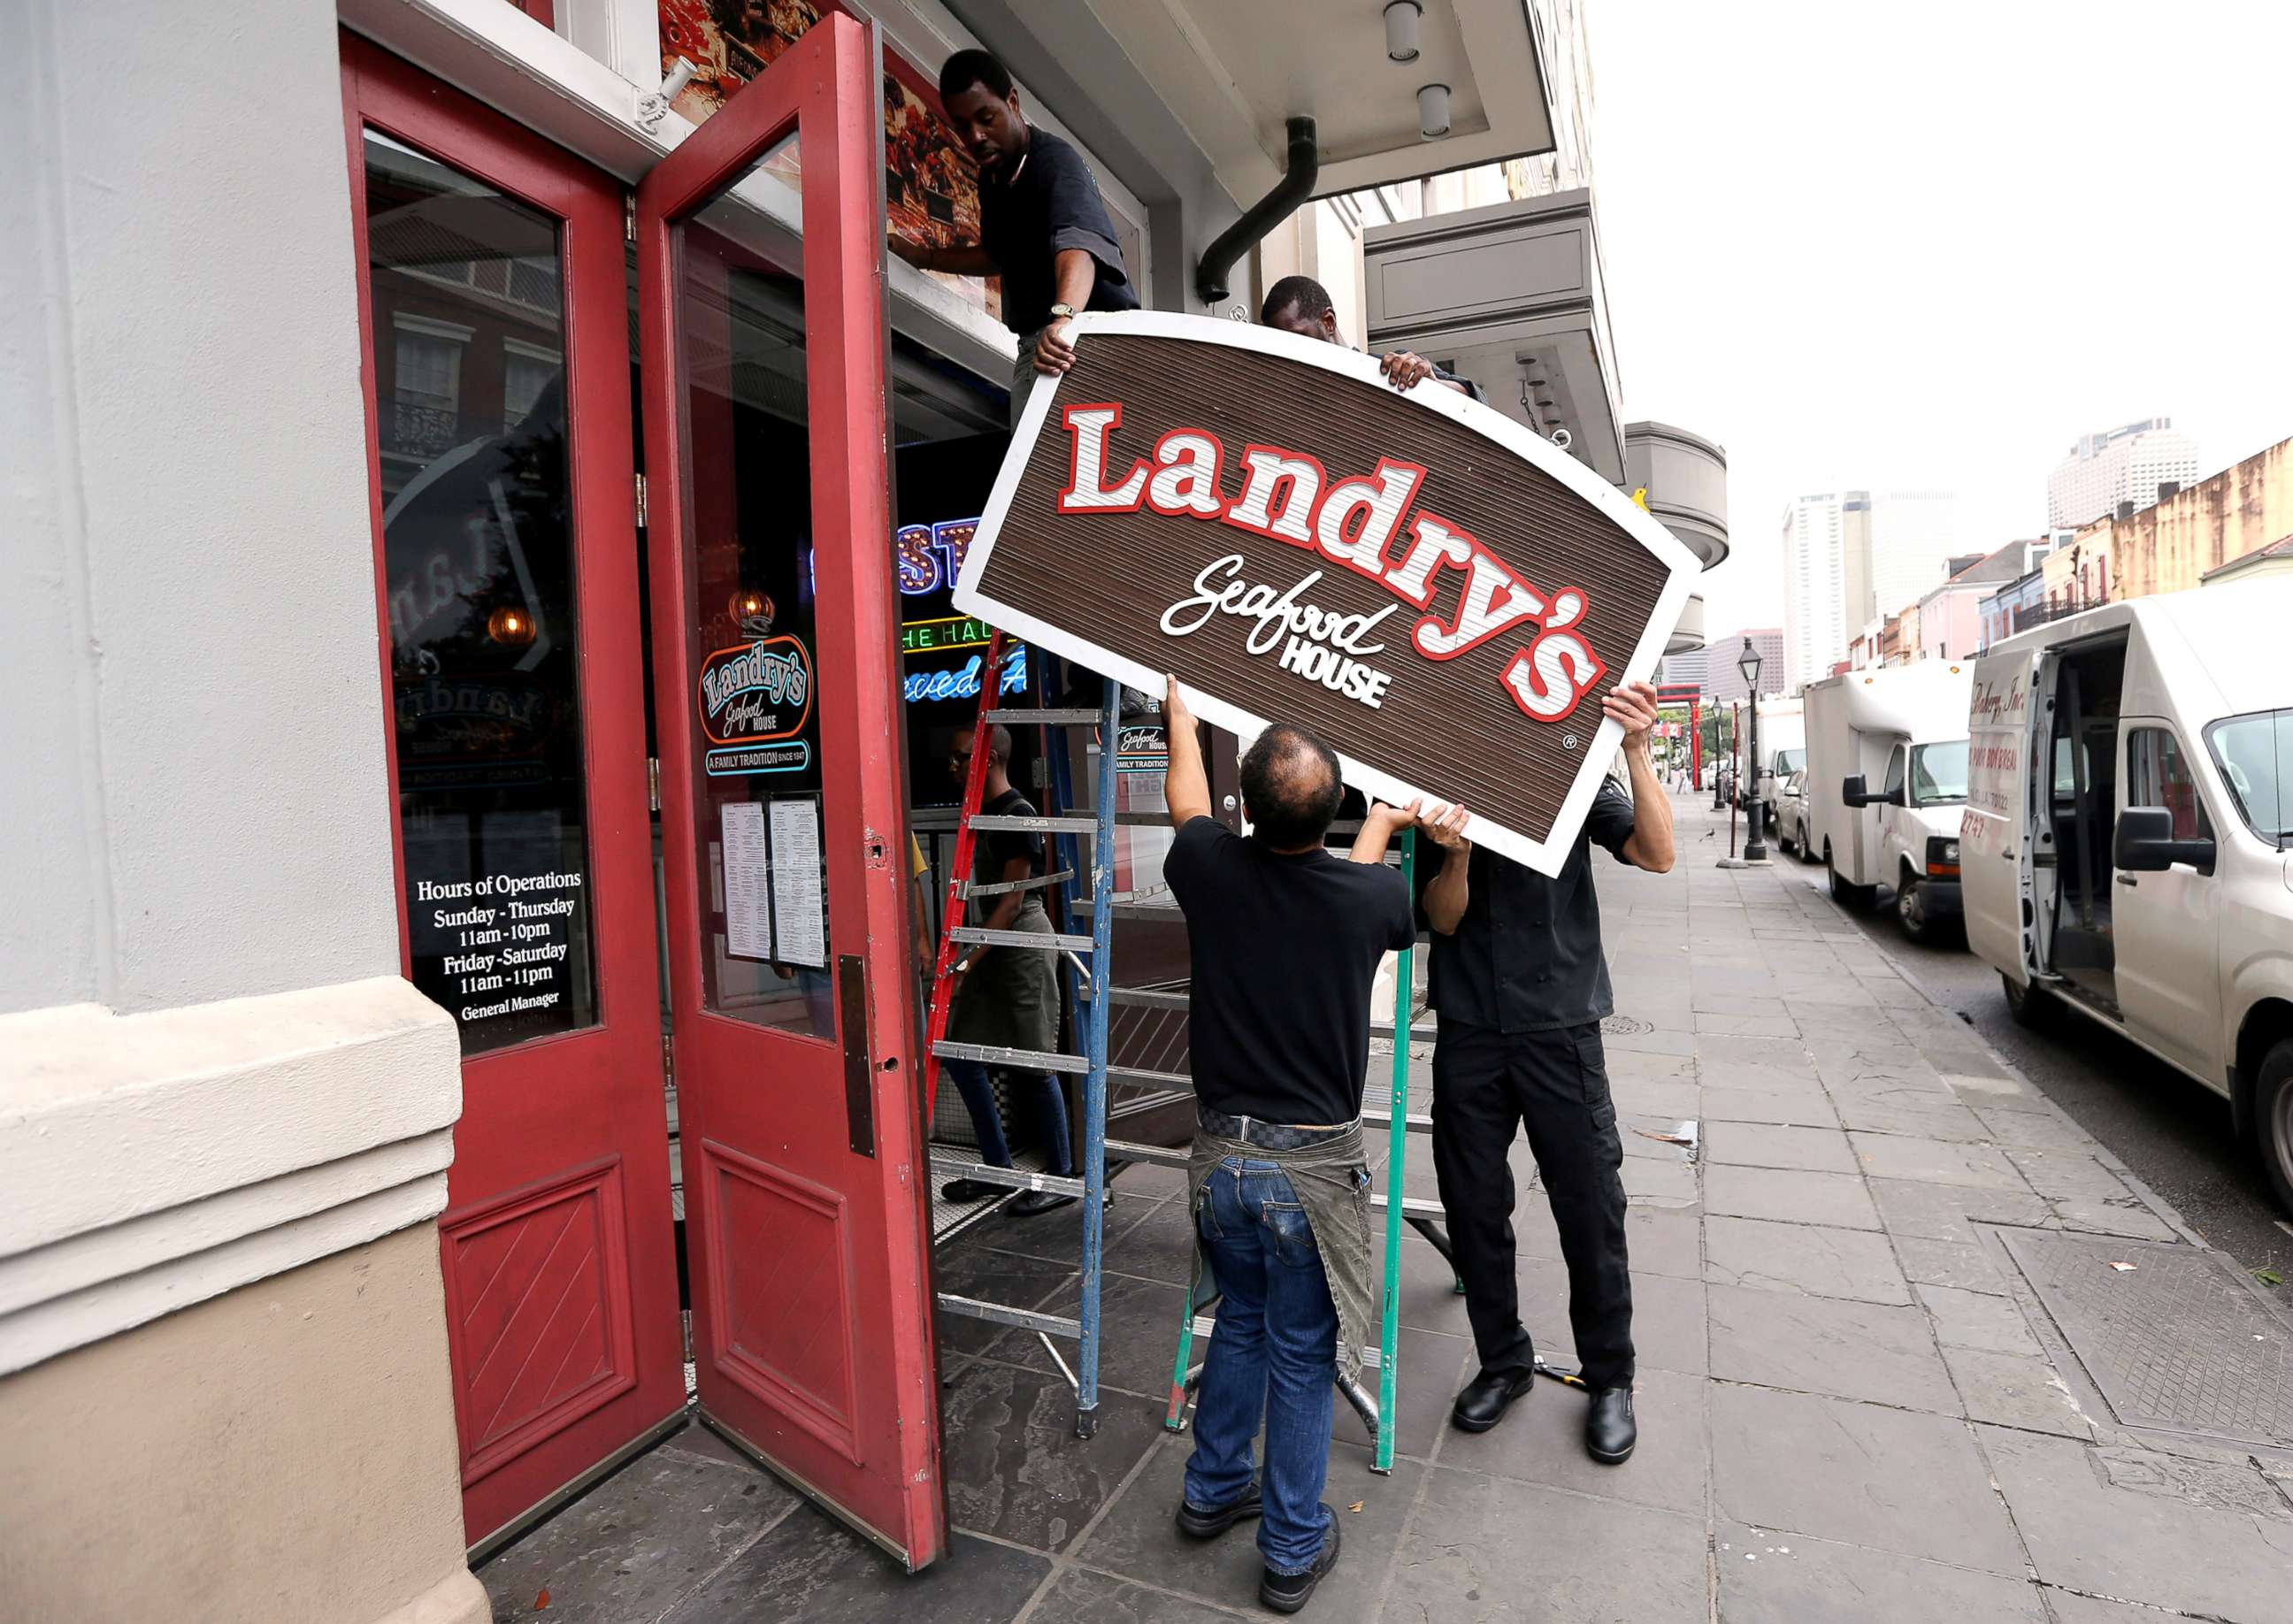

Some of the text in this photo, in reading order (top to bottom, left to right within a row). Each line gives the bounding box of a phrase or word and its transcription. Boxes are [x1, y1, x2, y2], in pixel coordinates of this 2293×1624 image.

[898, 517, 982, 594] ST
[1058, 402, 1607, 723] Landry's
[1160, 555, 1399, 655] Seafood
[902, 621, 993, 648] HE HAL
[703, 641, 807, 716] Landry's
[999, 645, 1027, 696] A
[1277, 634, 1393, 709] HOUSE
[723, 693, 763, 738] Seafood
[753, 715, 777, 732] HOUSE
[1121, 729, 1159, 752] Seafood
[1149, 741, 1167, 750] HOUS
[715, 755, 739, 769] FAMILY
[740, 752, 778, 766] TRADITION
[778, 752, 793, 762] SINCE
[418, 871, 581, 901] Hours of Operations
[433, 906, 496, 928] Sunday
[508, 898, 575, 919] Thursday
[443, 953, 495, 975] Friday
[461, 992, 559, 1021] General Manager
